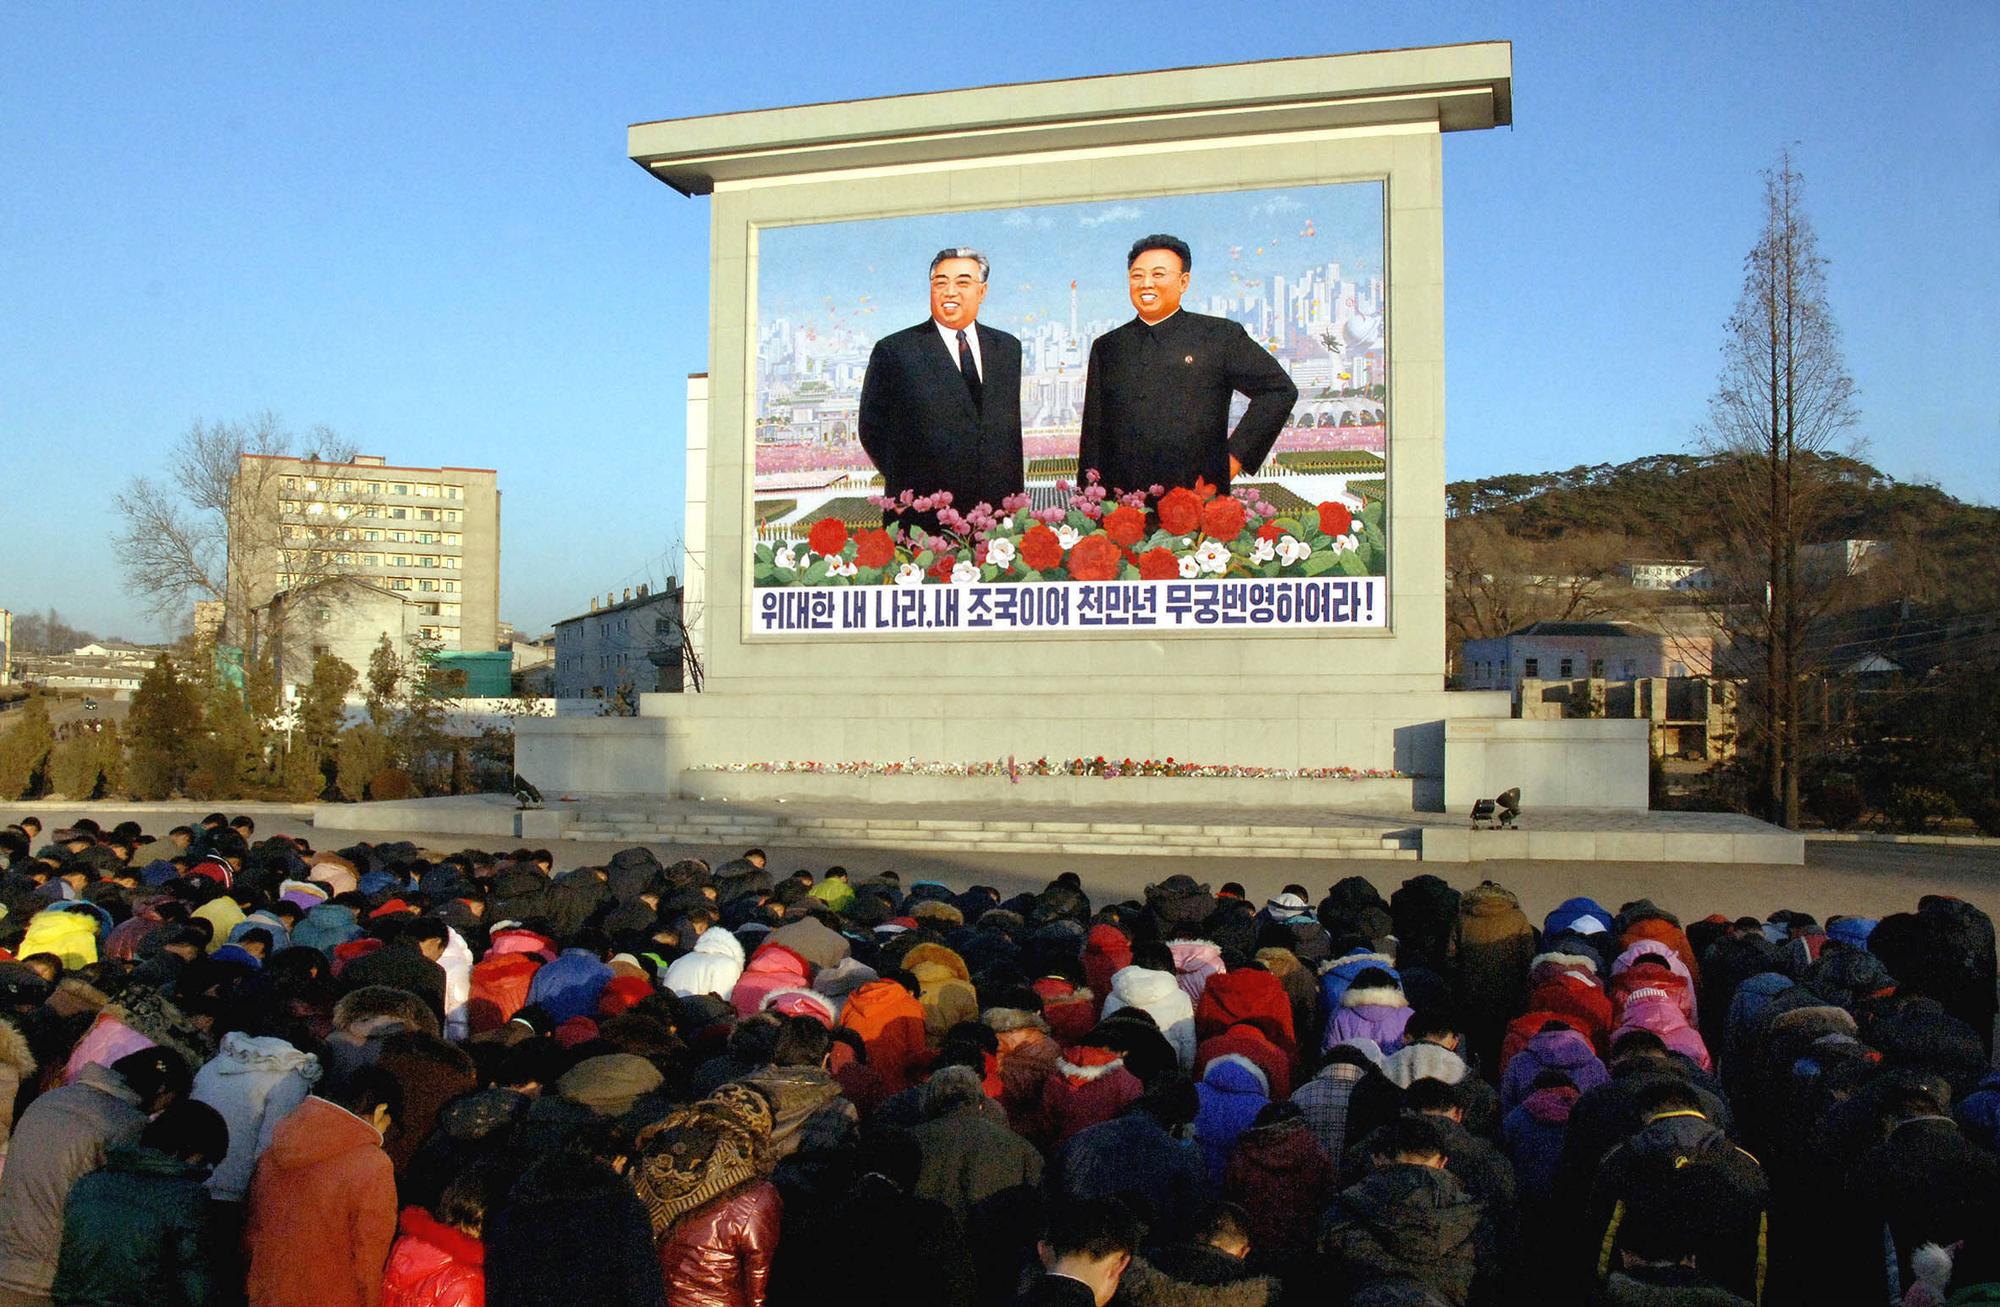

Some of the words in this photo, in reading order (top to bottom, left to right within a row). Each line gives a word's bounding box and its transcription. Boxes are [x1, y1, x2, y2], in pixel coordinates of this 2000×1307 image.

[762, 592, 835, 629] 위대한
[843, 591, 867, 629] 내
[968, 587, 1069, 627] 조국이여
[1078, 586, 1157, 625] 천만년
